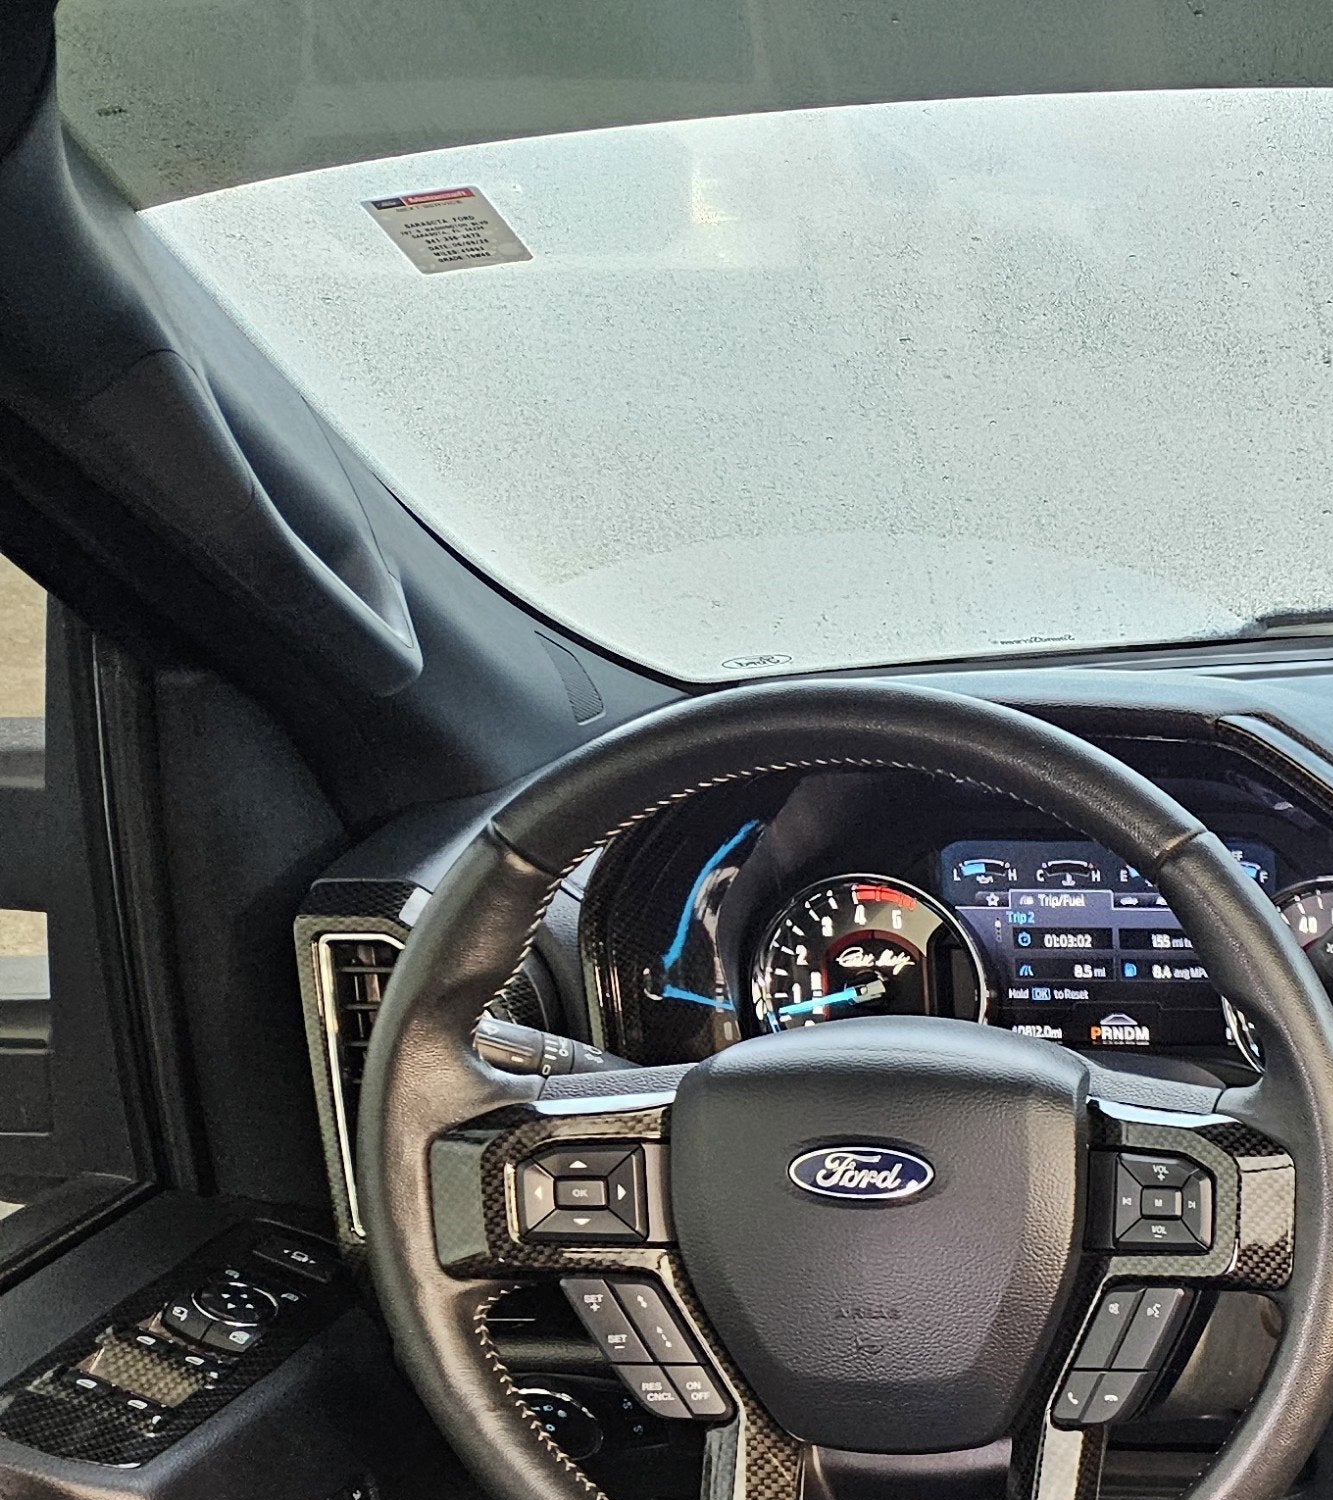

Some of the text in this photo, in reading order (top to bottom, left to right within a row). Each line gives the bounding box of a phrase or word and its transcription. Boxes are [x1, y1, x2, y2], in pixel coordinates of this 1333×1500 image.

[1038, 894, 1086, 908] Trip/Fuel
[854, 904, 867, 925] 4
[1009, 988, 1029, 1000] Hold
[815, 1152, 901, 1189] Ford
[1152, 1164, 1169, 1174] VOL
[572, 1188, 588, 1198] OK
[1151, 1225, 1167, 1235] VOL
[584, 1294, 603, 1302] SET
[607, 1334, 628, 1343] SET
[642, 1382, 662, 1390] RES
[686, 1382, 701, 1390] ON
[646, 1393, 675, 1401] CNCL
[691, 1392, 711, 1401] OFF
